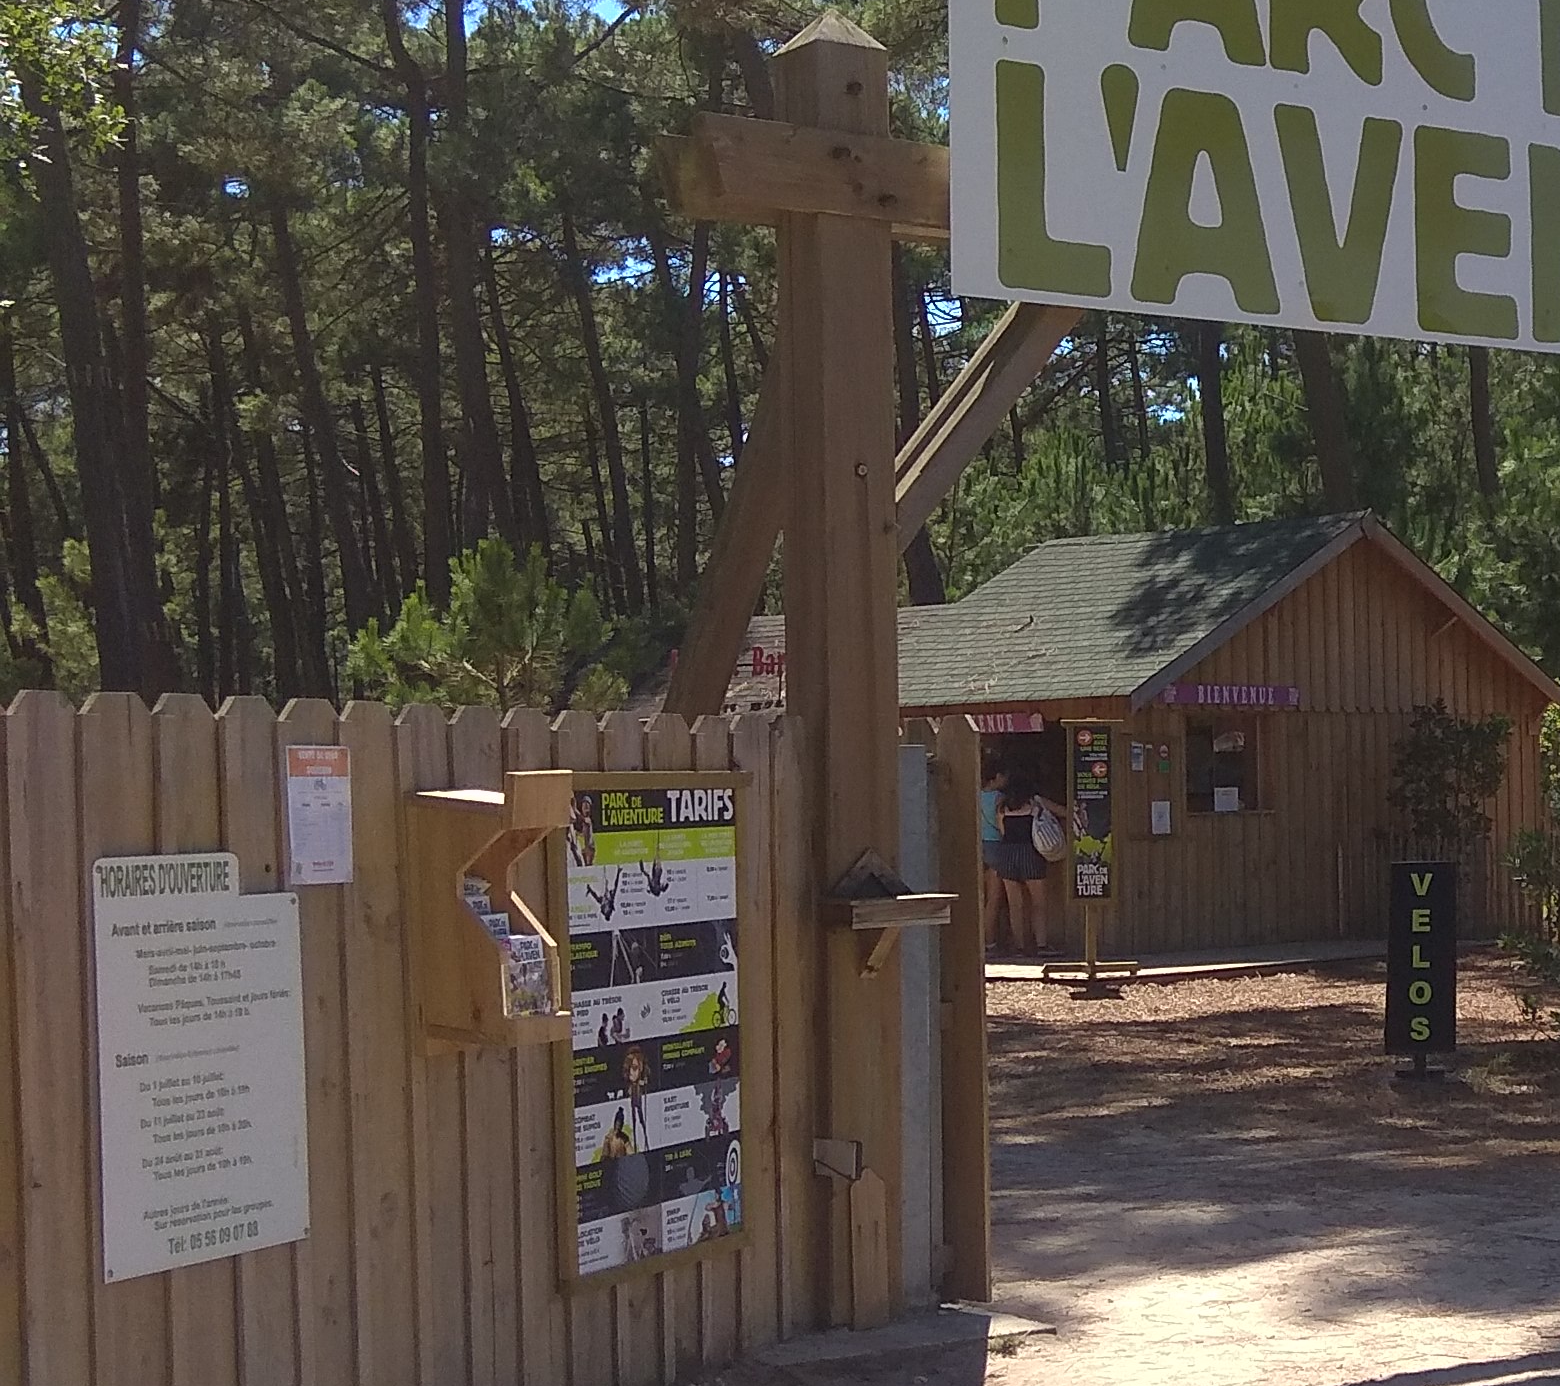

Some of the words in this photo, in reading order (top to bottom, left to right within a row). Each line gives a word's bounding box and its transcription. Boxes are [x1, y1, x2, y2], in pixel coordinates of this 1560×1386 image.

[1198, 685, 1274, 704] BIENVENUE
[602, 792, 628, 808] PARC
[632, 797, 642, 807] DE
[667, 788, 733, 823] TARIFS
[602, 808, 663, 826] L'AVENTURE
[1077, 864, 1099, 874] PARC
[100, 864, 156, 898] HORAIRES
[159, 861, 230, 895] D'OUVERTURE
[1077, 875, 1108, 884] L'AVEN
[1077, 886, 1103, 896] TURE
[112, 923, 139, 937] Avant
[142, 923, 151, 935] et
[186, 919, 216, 931] saison
[1409, 873, 1433, 1040] VELOS
[149, 976, 186, 988] Dimanche
[188, 974, 197, 984] de
[242, 994, 249, 1003] et
[251, 992, 268, 1004] jours
[661, 987, 681, 997] CHASSE
[593, 998, 600, 1006] AU
[149, 1016, 168, 1027] Tous
[182, 1014, 200, 1025] jours
[201, 1012, 212, 1021] de
[115, 1053, 149, 1068] Saison
[152, 1097, 170, 1107] Tous
[185, 1093, 204, 1105] jours
[206, 1091, 215, 1100] de
[153, 1133, 171, 1143] Tous
[186, 1129, 204, 1141] jours
[206, 1127, 216, 1136] de
[153, 1170, 172, 1181] Tous
[174, 1168, 185, 1177] les
[186, 1166, 205, 1178] jours
[207, 1164, 216, 1172] de
[144, 1209, 168, 1220] Autres
[171, 1205, 190, 1218] jours
[191, 1202, 200, 1210] de
[154, 1221, 167, 1231] Sur
[213, 1209, 231, 1222] pour
[190, 1233, 202, 1249] 05
[205, 1230, 216, 1246] 56
[219, 1227, 230, 1243] 09
[233, 1224, 244, 1240] 07
